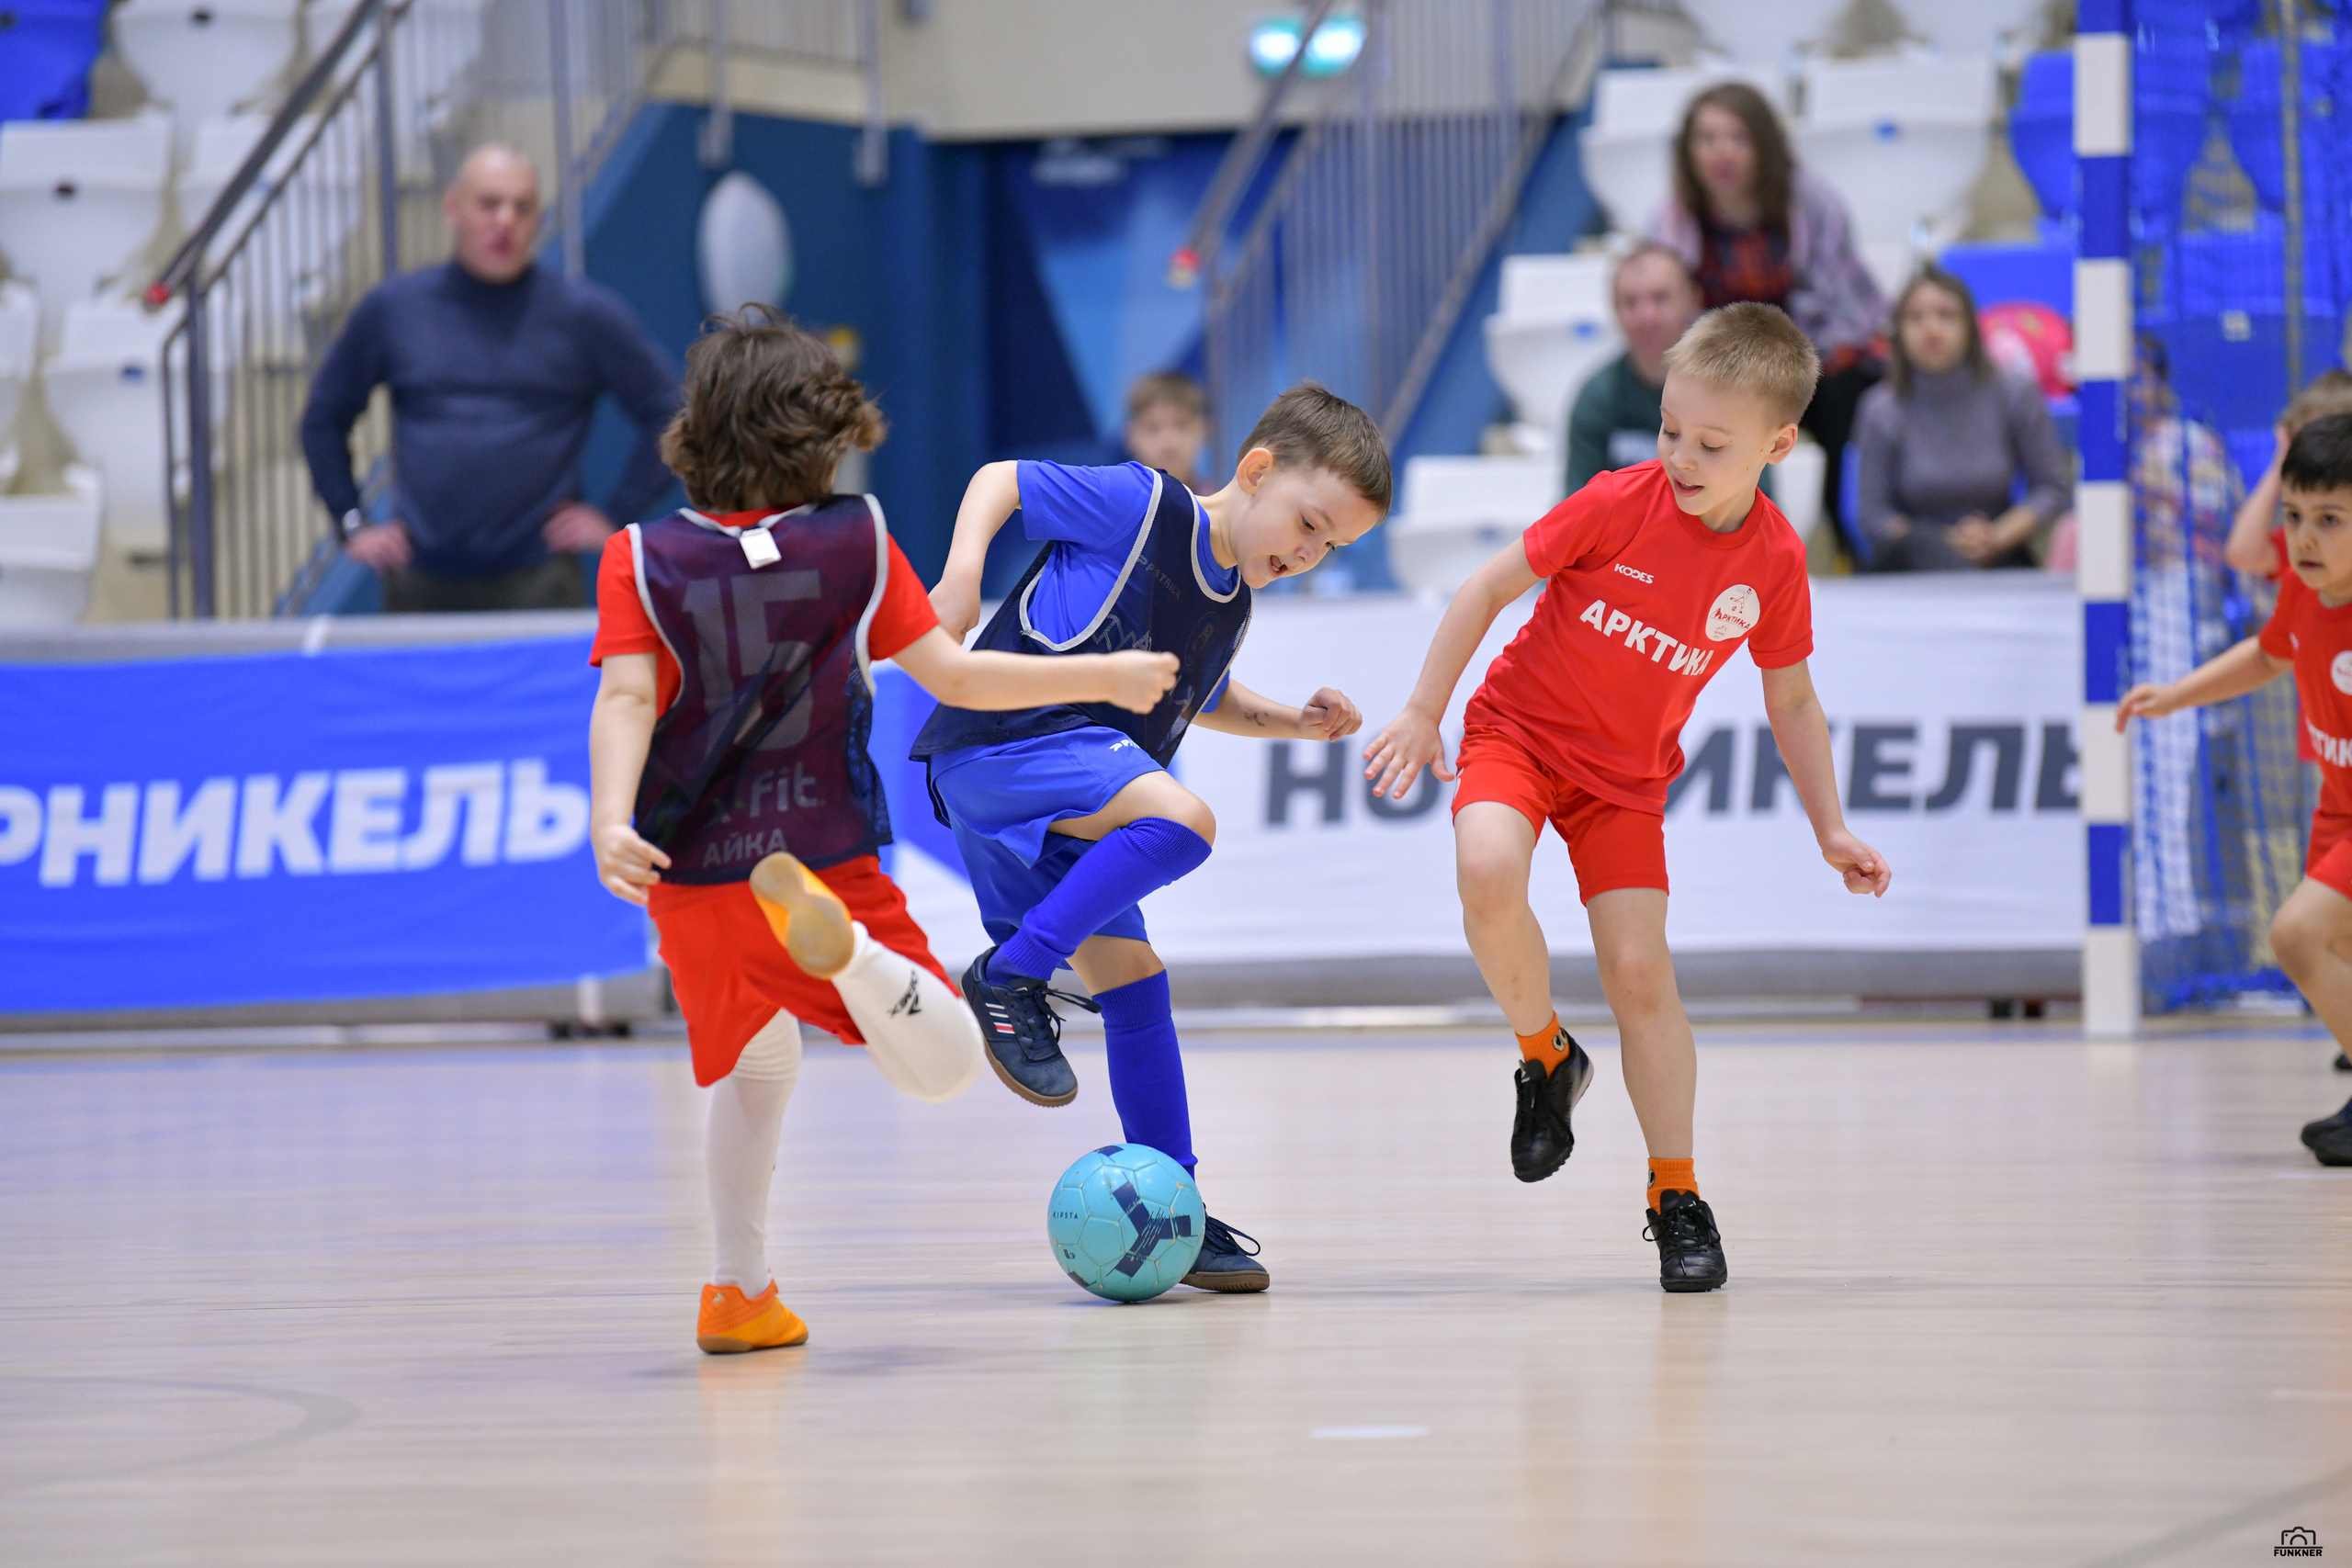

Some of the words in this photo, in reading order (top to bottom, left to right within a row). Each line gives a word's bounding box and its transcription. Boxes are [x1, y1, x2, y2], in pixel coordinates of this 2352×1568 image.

[1614, 563, 1654, 584] KODES
[1579, 599, 1714, 676] АРКТИКА
[681, 570, 823, 762] 15
[1052, 1212, 1079, 1220] KIPSTA
